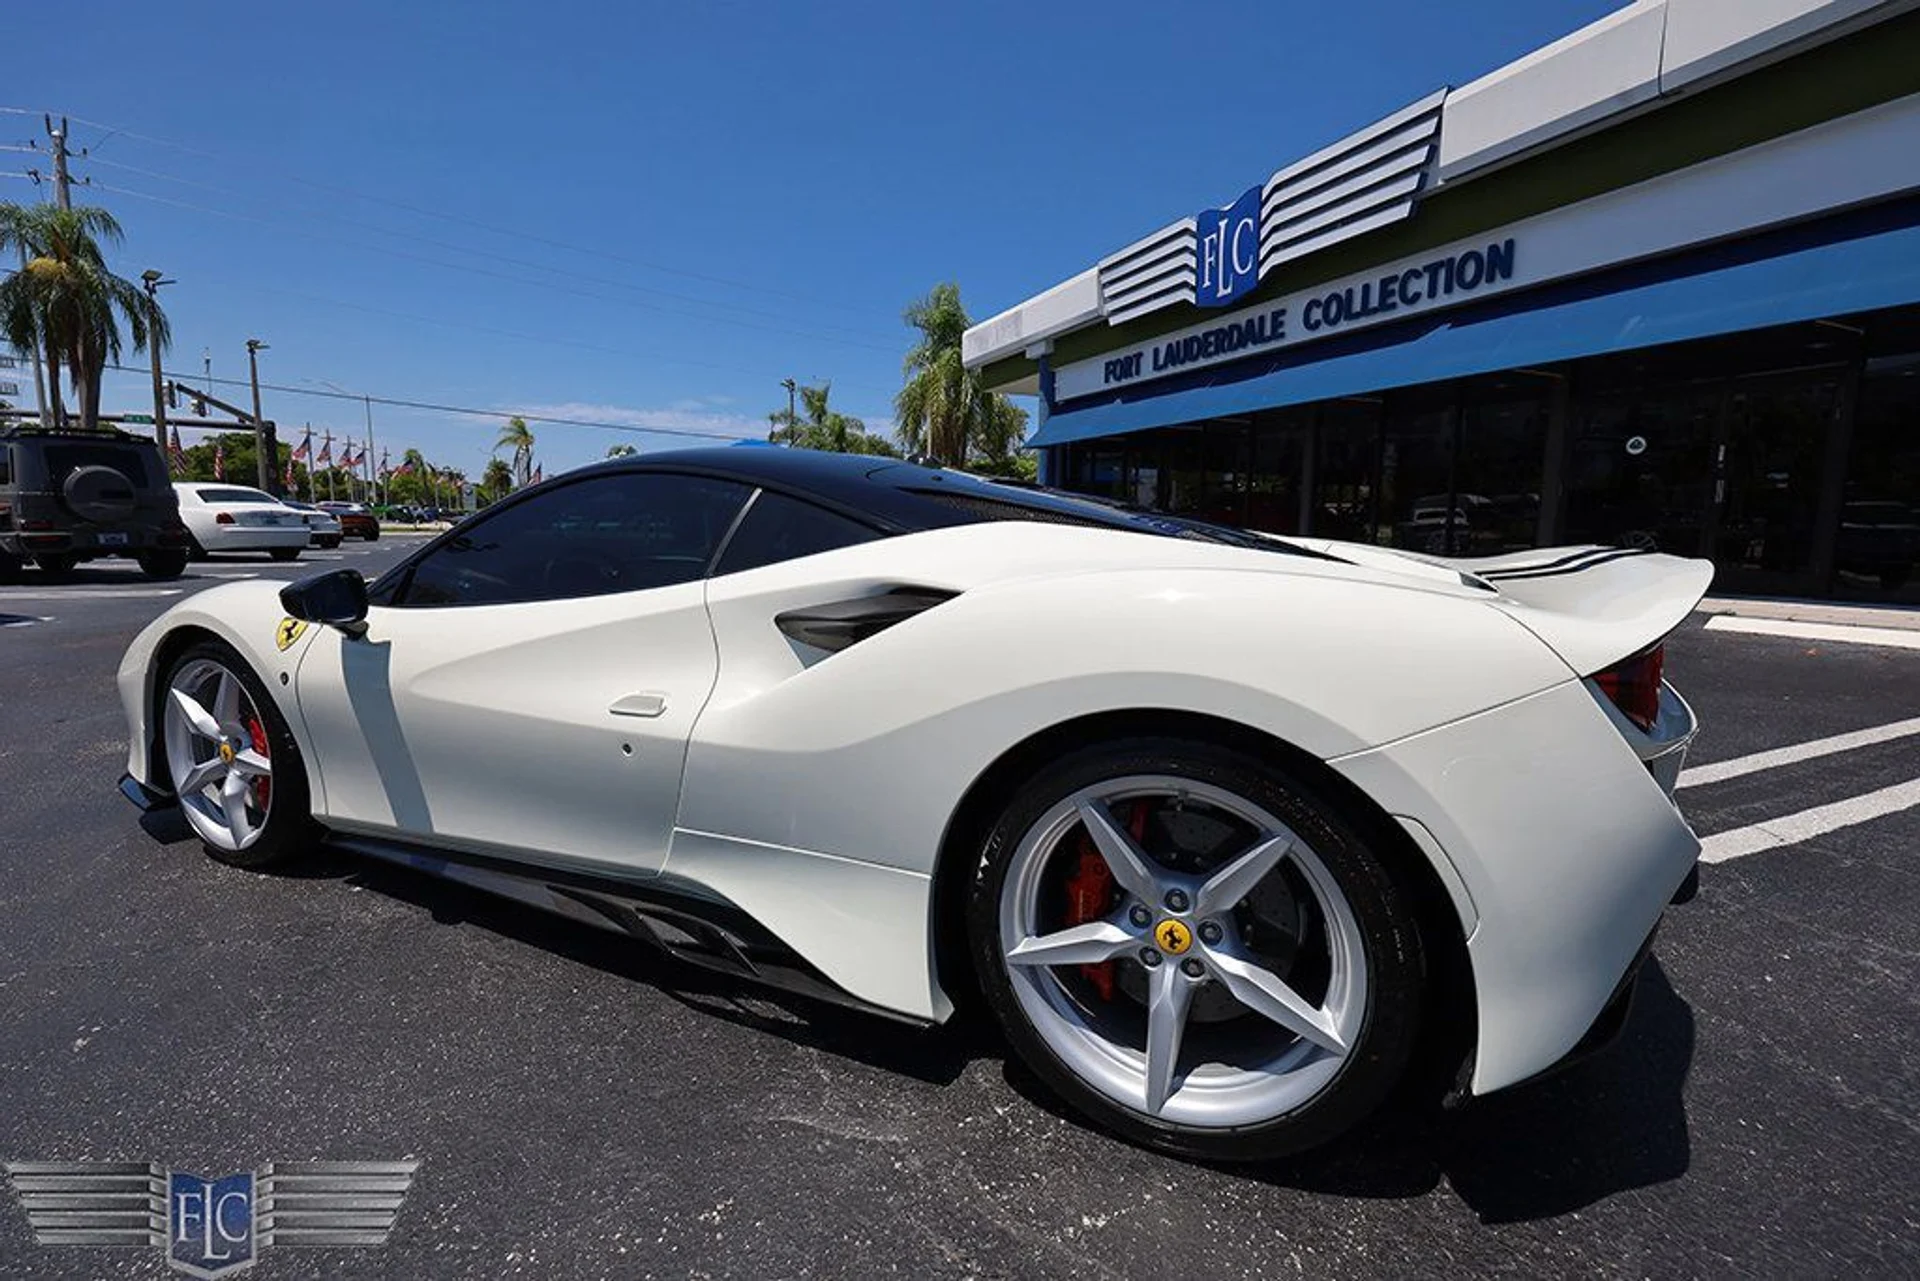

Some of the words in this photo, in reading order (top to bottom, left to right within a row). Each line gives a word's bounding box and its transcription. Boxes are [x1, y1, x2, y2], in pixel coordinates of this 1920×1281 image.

[1104, 352, 1144, 384] FORT
[1152, 308, 1287, 371] LAUDERDALE
[1303, 238, 1515, 331] COLLECTION
[1202, 217, 1254, 298] FLC
